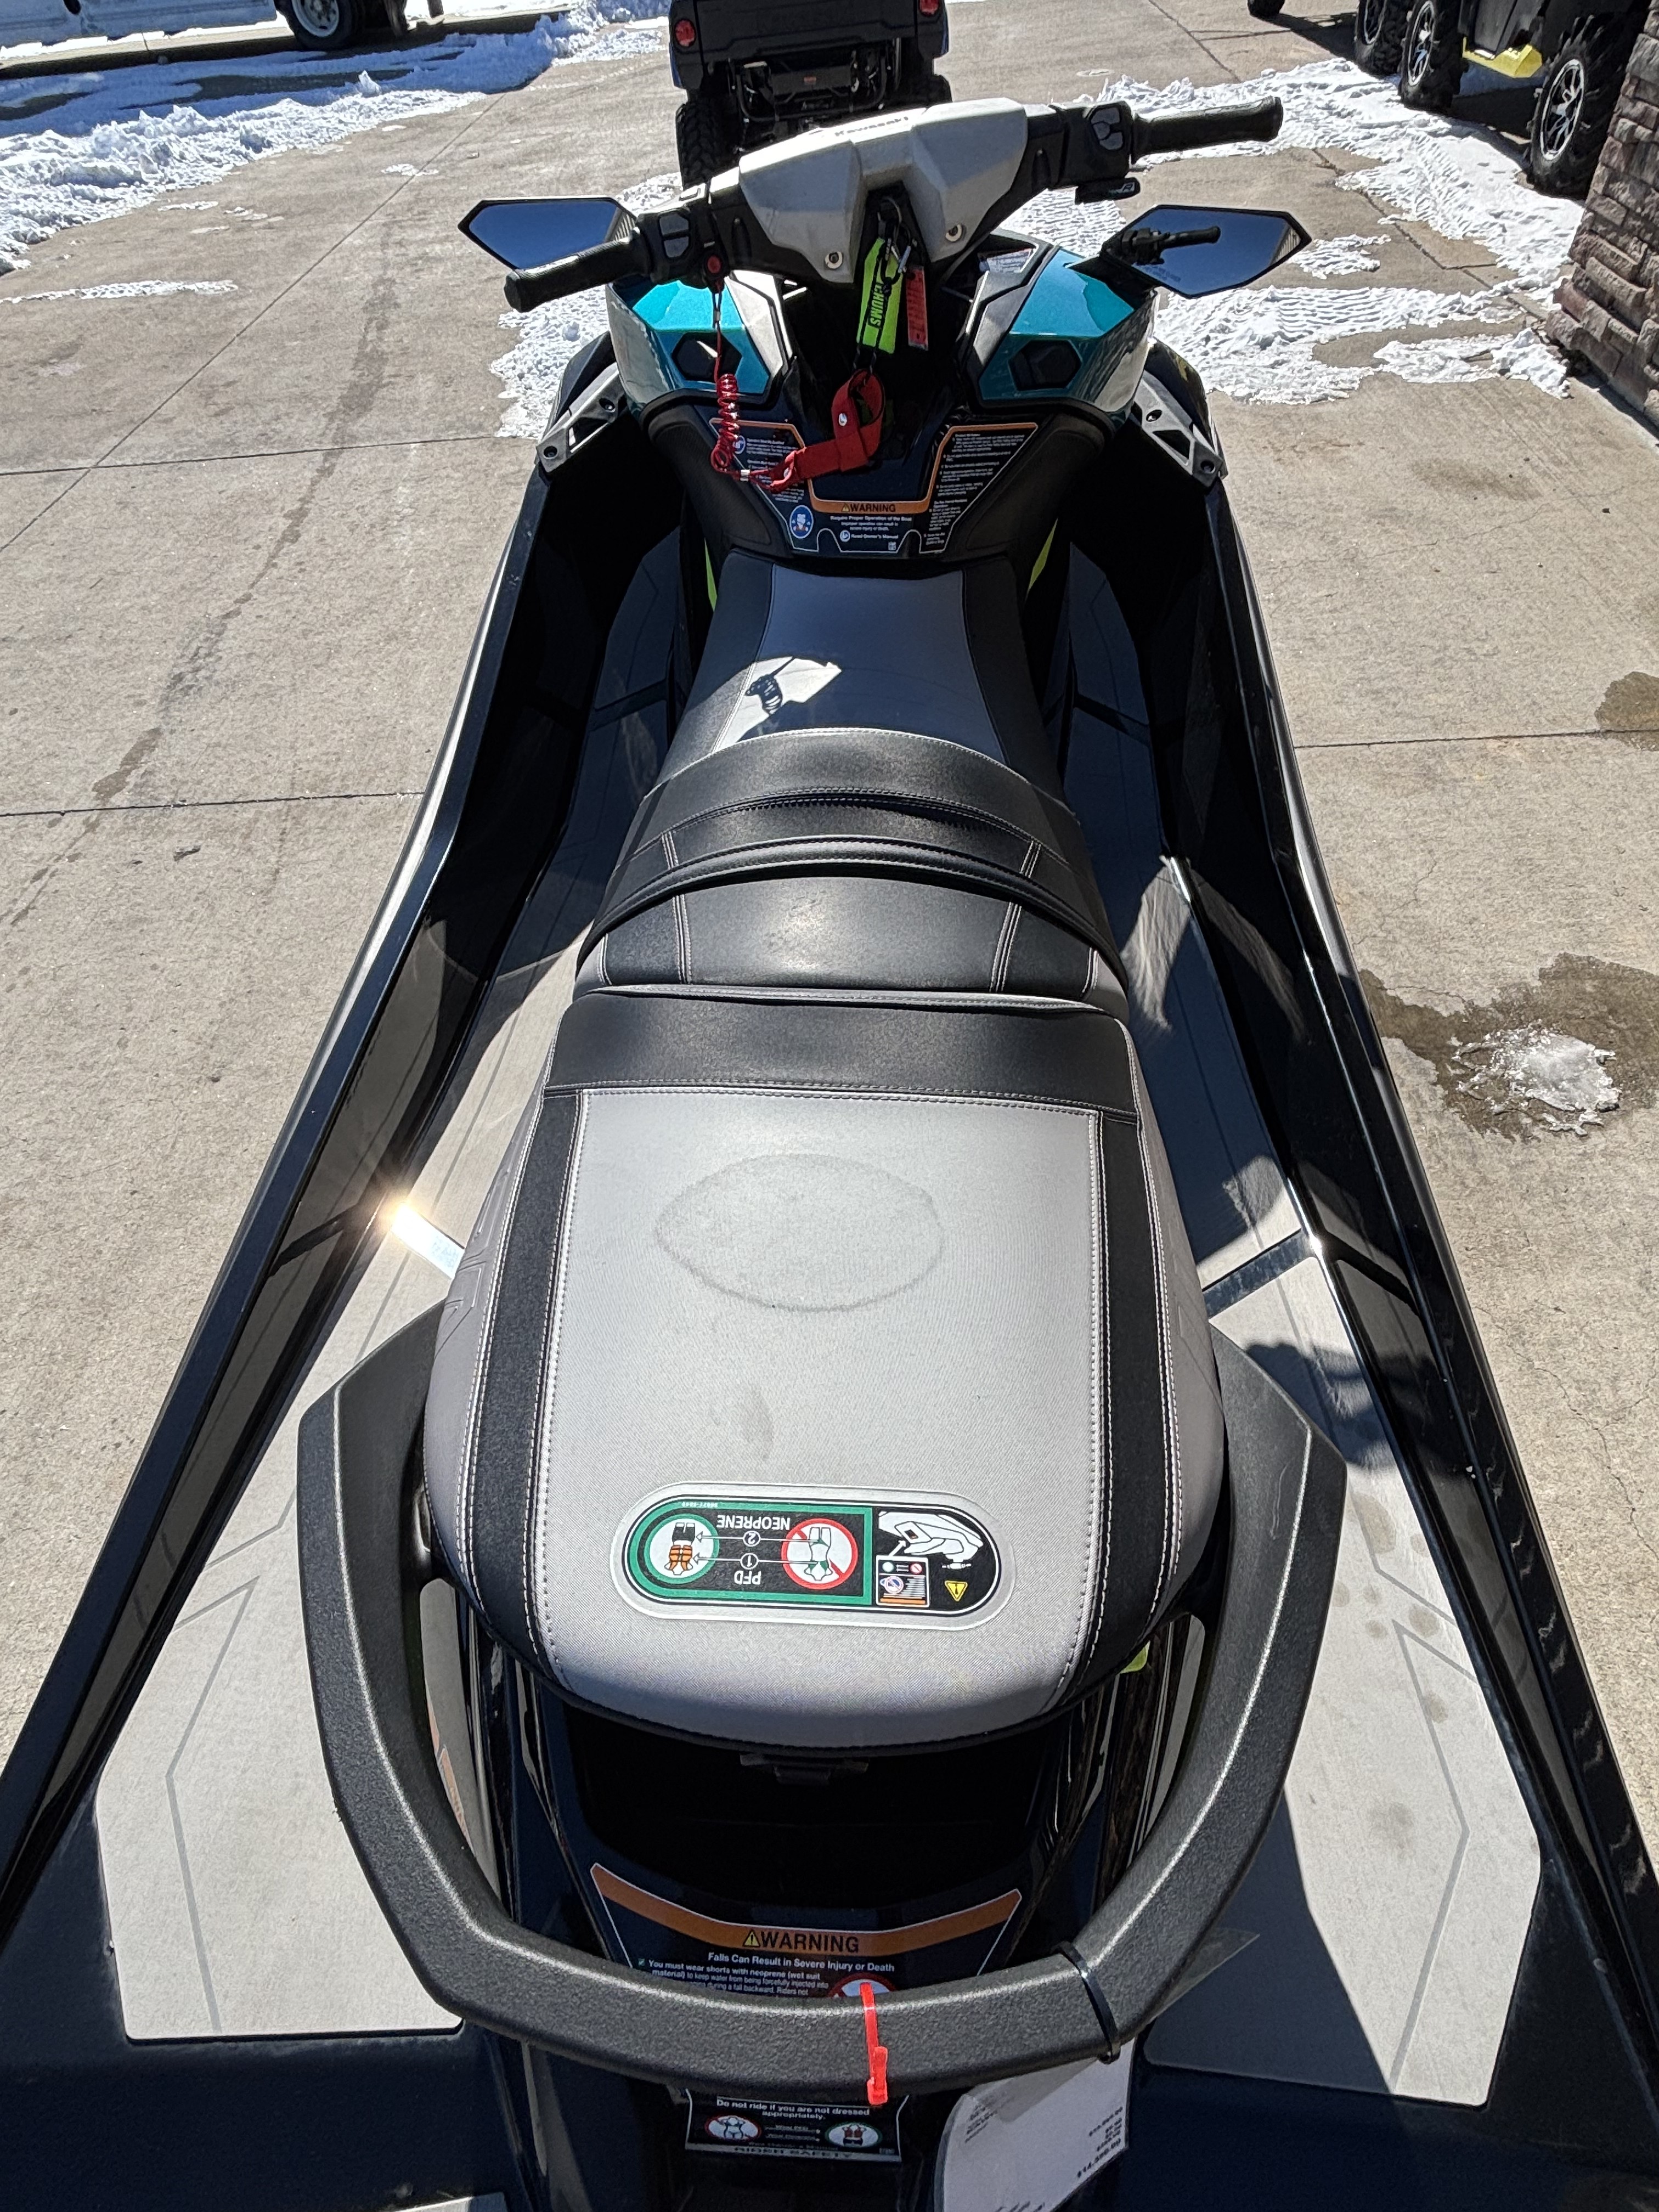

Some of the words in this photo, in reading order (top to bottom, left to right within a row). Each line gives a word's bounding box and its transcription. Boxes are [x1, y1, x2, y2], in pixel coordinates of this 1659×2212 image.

[850, 504, 896, 512] WARNING
[716, 1514, 791, 1531] NEOPRENE
[748, 1532, 756, 1544] 2
[747, 1554, 752, 1567] 1
[733, 1569, 761, 1585] PFD
[761, 1931, 859, 1953] WARNING
[648, 1960, 664, 1968] You
[706, 1965, 730, 1974] shorts
[732, 1967, 748, 1976] with
[749, 1970, 786, 1978] neoprene
[788, 1971, 804, 1980] (wet
[708, 1952, 730, 1962] Falls
[731, 1954, 750, 1963] Can
[752, 1955, 781, 1966] Result
[794, 1959, 825, 1968] Severe
[827, 1960, 853, 1972] Injury
[867, 1962, 895, 1972] Death
[652, 1970, 686, 1979] material)
[695, 1973, 710, 1982] keep
[744, 1977, 761, 1986] being
[791, 1980, 816, 1989] injected
[776, 1987, 797, 1995] Riders
[716, 2098, 731, 2108] Do
[732, 2101, 747, 2109] not
[749, 2101, 768, 2111] ride
[777, 2105, 795, 2113] you
[815, 2106, 830, 2115] not
[832, 2107, 870, 2116] dressed
[761, 2111, 826, 2120] appropriately.
